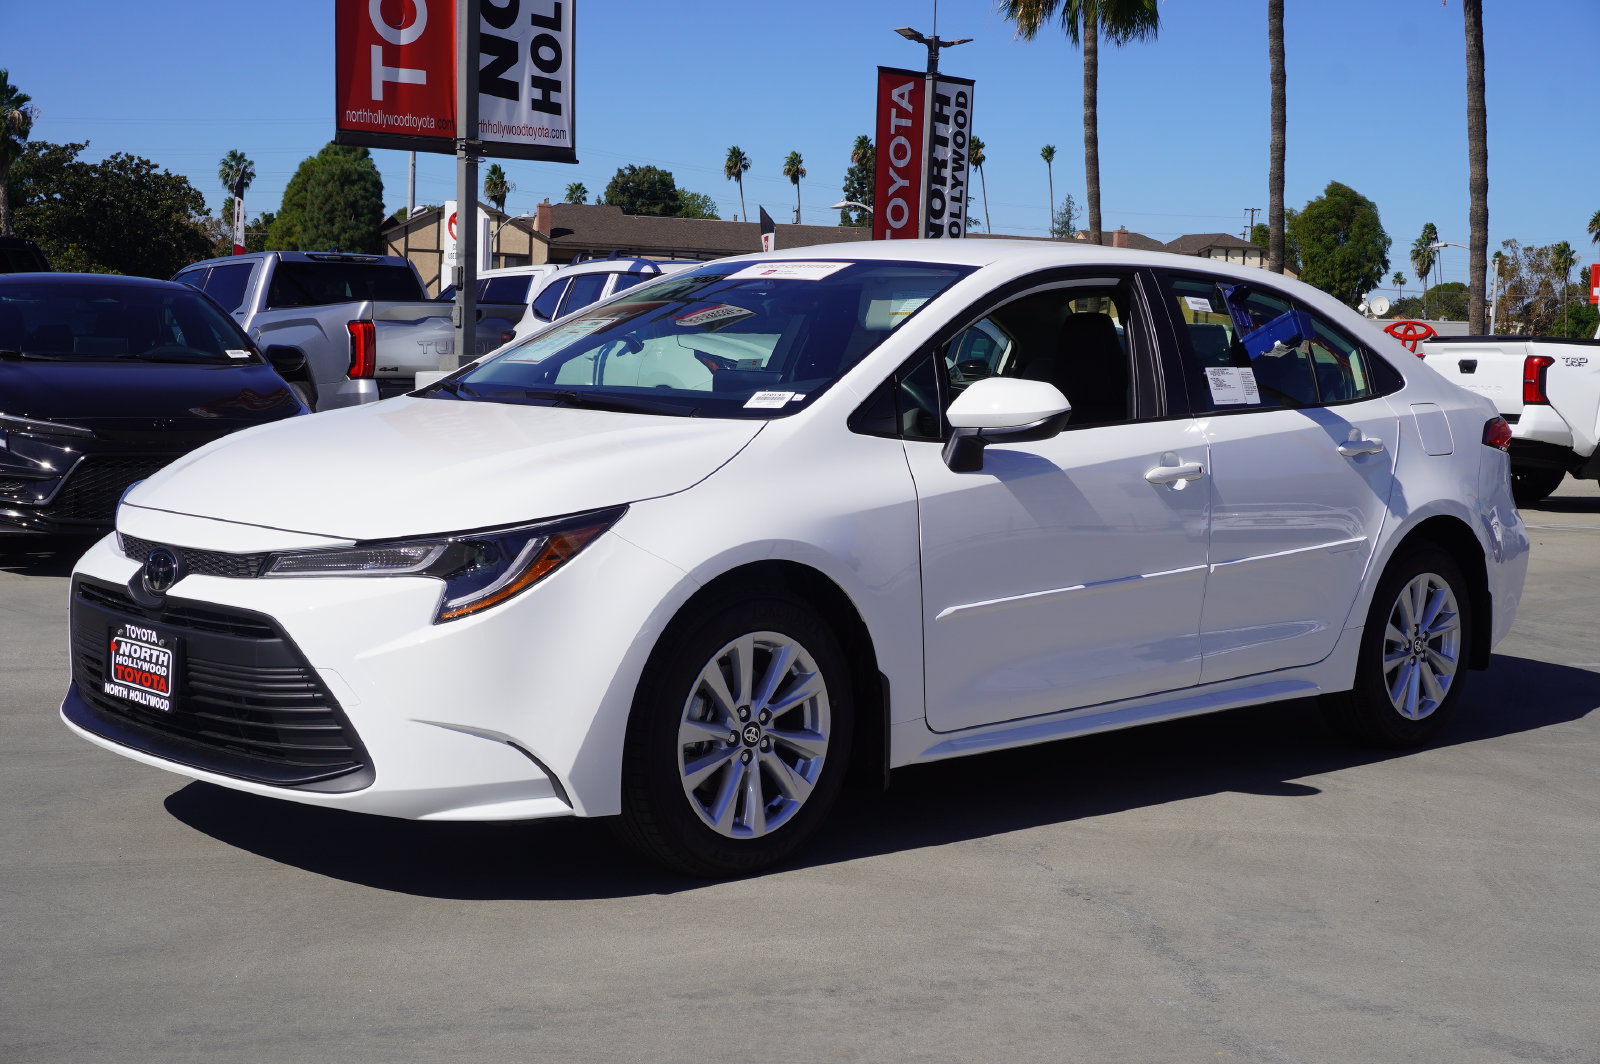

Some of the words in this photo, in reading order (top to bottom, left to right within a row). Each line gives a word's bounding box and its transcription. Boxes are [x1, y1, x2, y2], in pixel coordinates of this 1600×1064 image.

[530, 1, 562, 116] HOL
[886, 81, 915, 240] OYOTA
[125, 624, 158, 643] TOYOTA
[115, 654, 167, 676] HOLLYWOOD
[119, 641, 168, 666] NORTH
[115, 665, 168, 692] TOYOTA
[104, 682, 128, 699] NORTH
[129, 689, 170, 711] HOLLYWOOD
